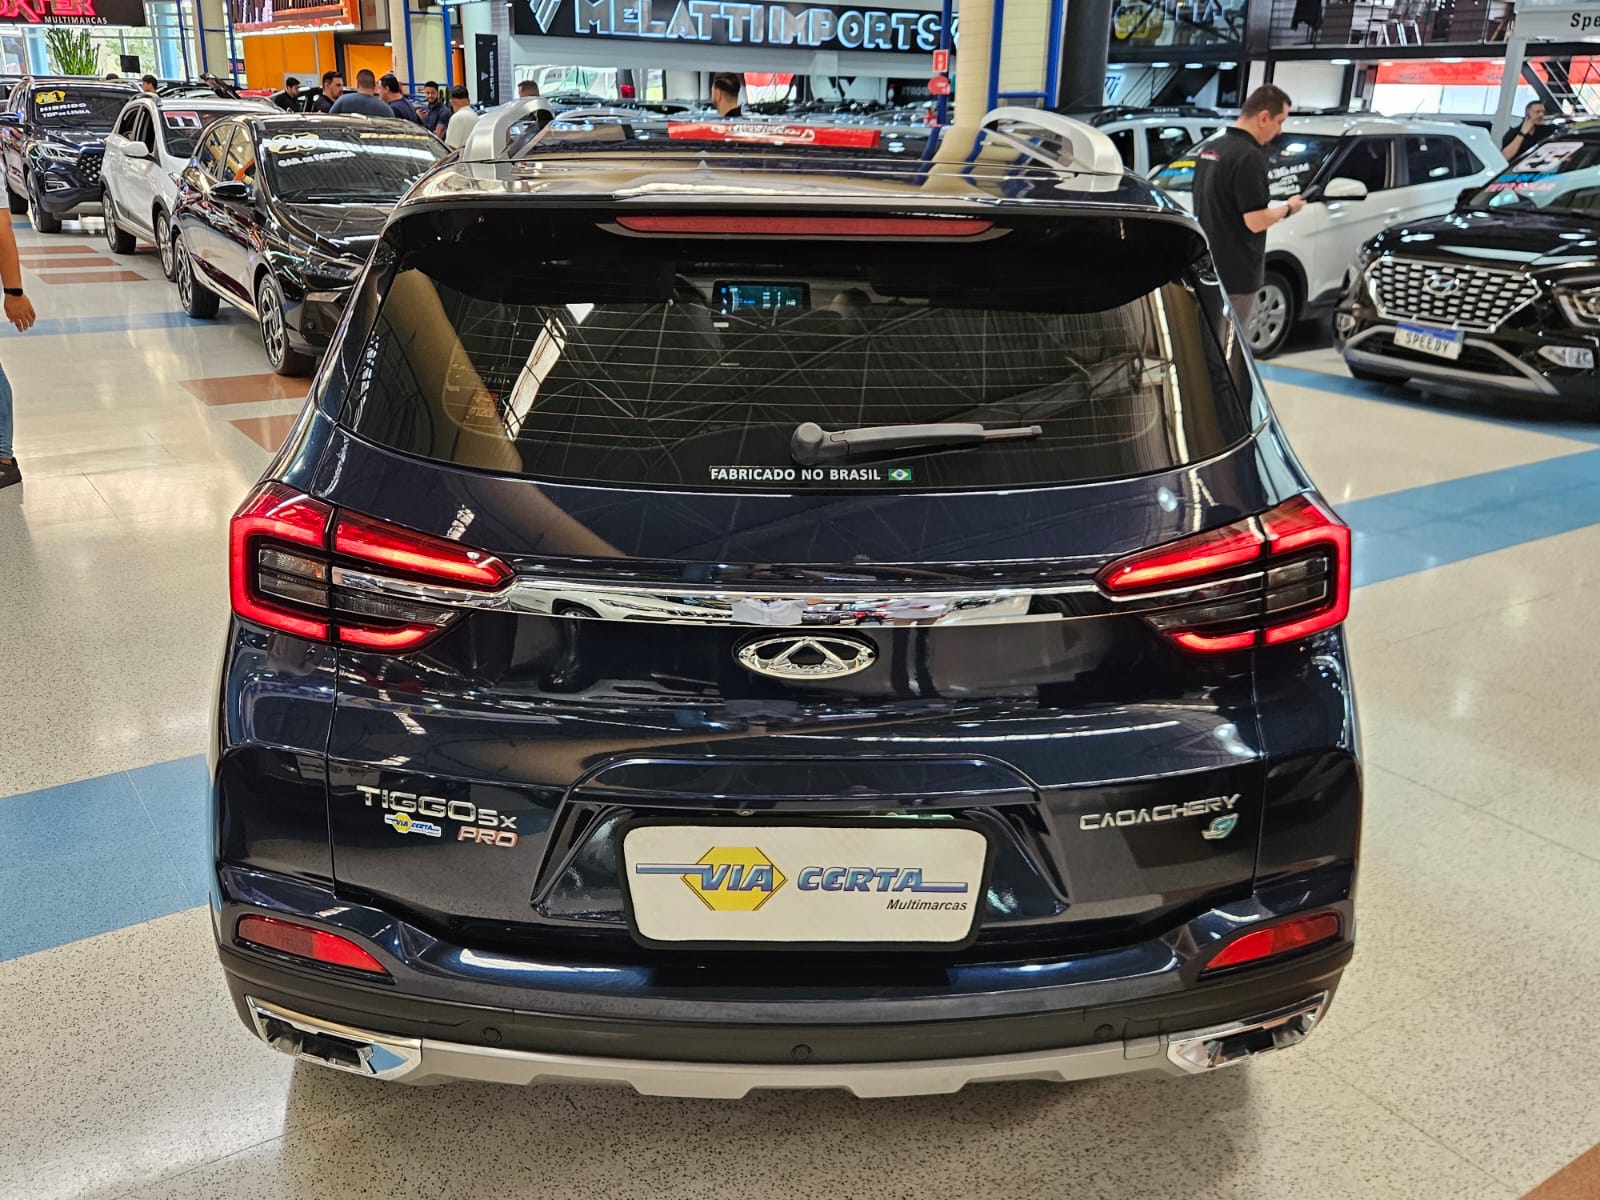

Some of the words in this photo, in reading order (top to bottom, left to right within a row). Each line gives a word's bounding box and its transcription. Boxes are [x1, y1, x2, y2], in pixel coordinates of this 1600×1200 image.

[44, 15, 108, 25] MULTIMARCAS
[574, 0, 764, 43] MELATTI
[769, 5, 942, 50] IMPORTS
[1404, 332, 1450, 353] SPEEDY
[710, 468, 796, 481] FABRICADO
[801, 468, 824, 481] NO
[829, 468, 881, 481] BRASIL
[457, 825, 519, 848] PRO
[700, 863, 774, 892] VIA
[797, 866, 923, 892] CERTA
[886, 898, 968, 912] Multimarcas
